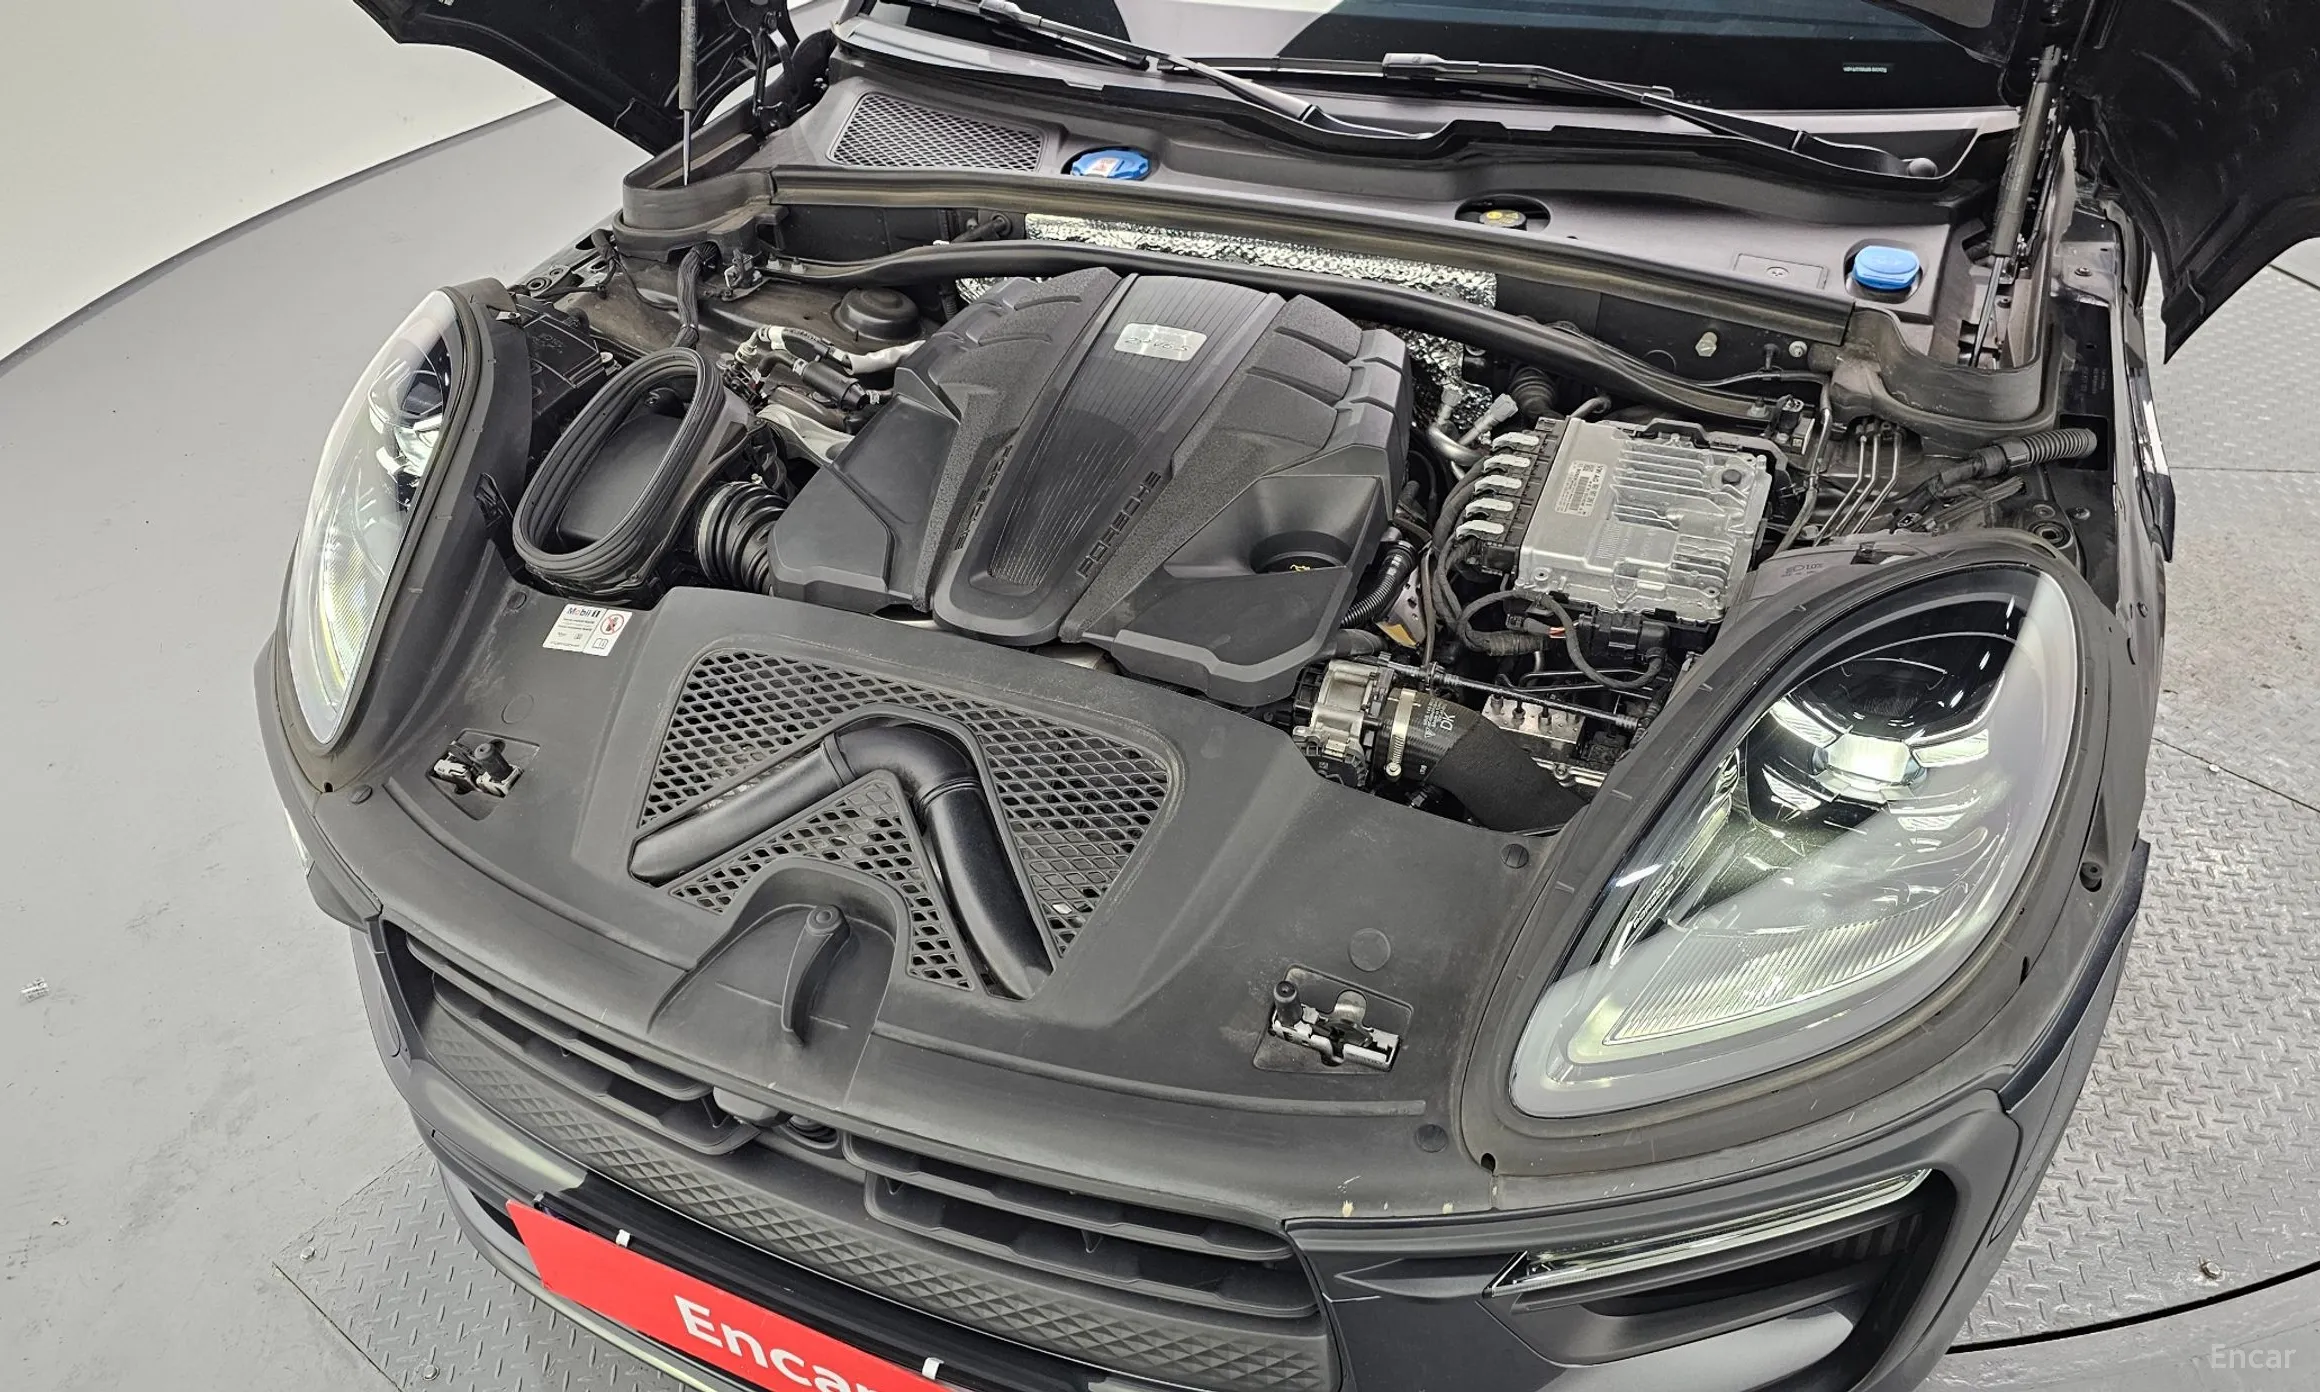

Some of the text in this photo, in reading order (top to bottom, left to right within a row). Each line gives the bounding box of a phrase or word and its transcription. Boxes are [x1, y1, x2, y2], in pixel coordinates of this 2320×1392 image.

[954, 444, 1013, 551] PORSCHE
[1076, 471, 1162, 579] PORSCHE
[567, 606, 591, 616] Mobil
[1440, 711, 1455, 731] DK
